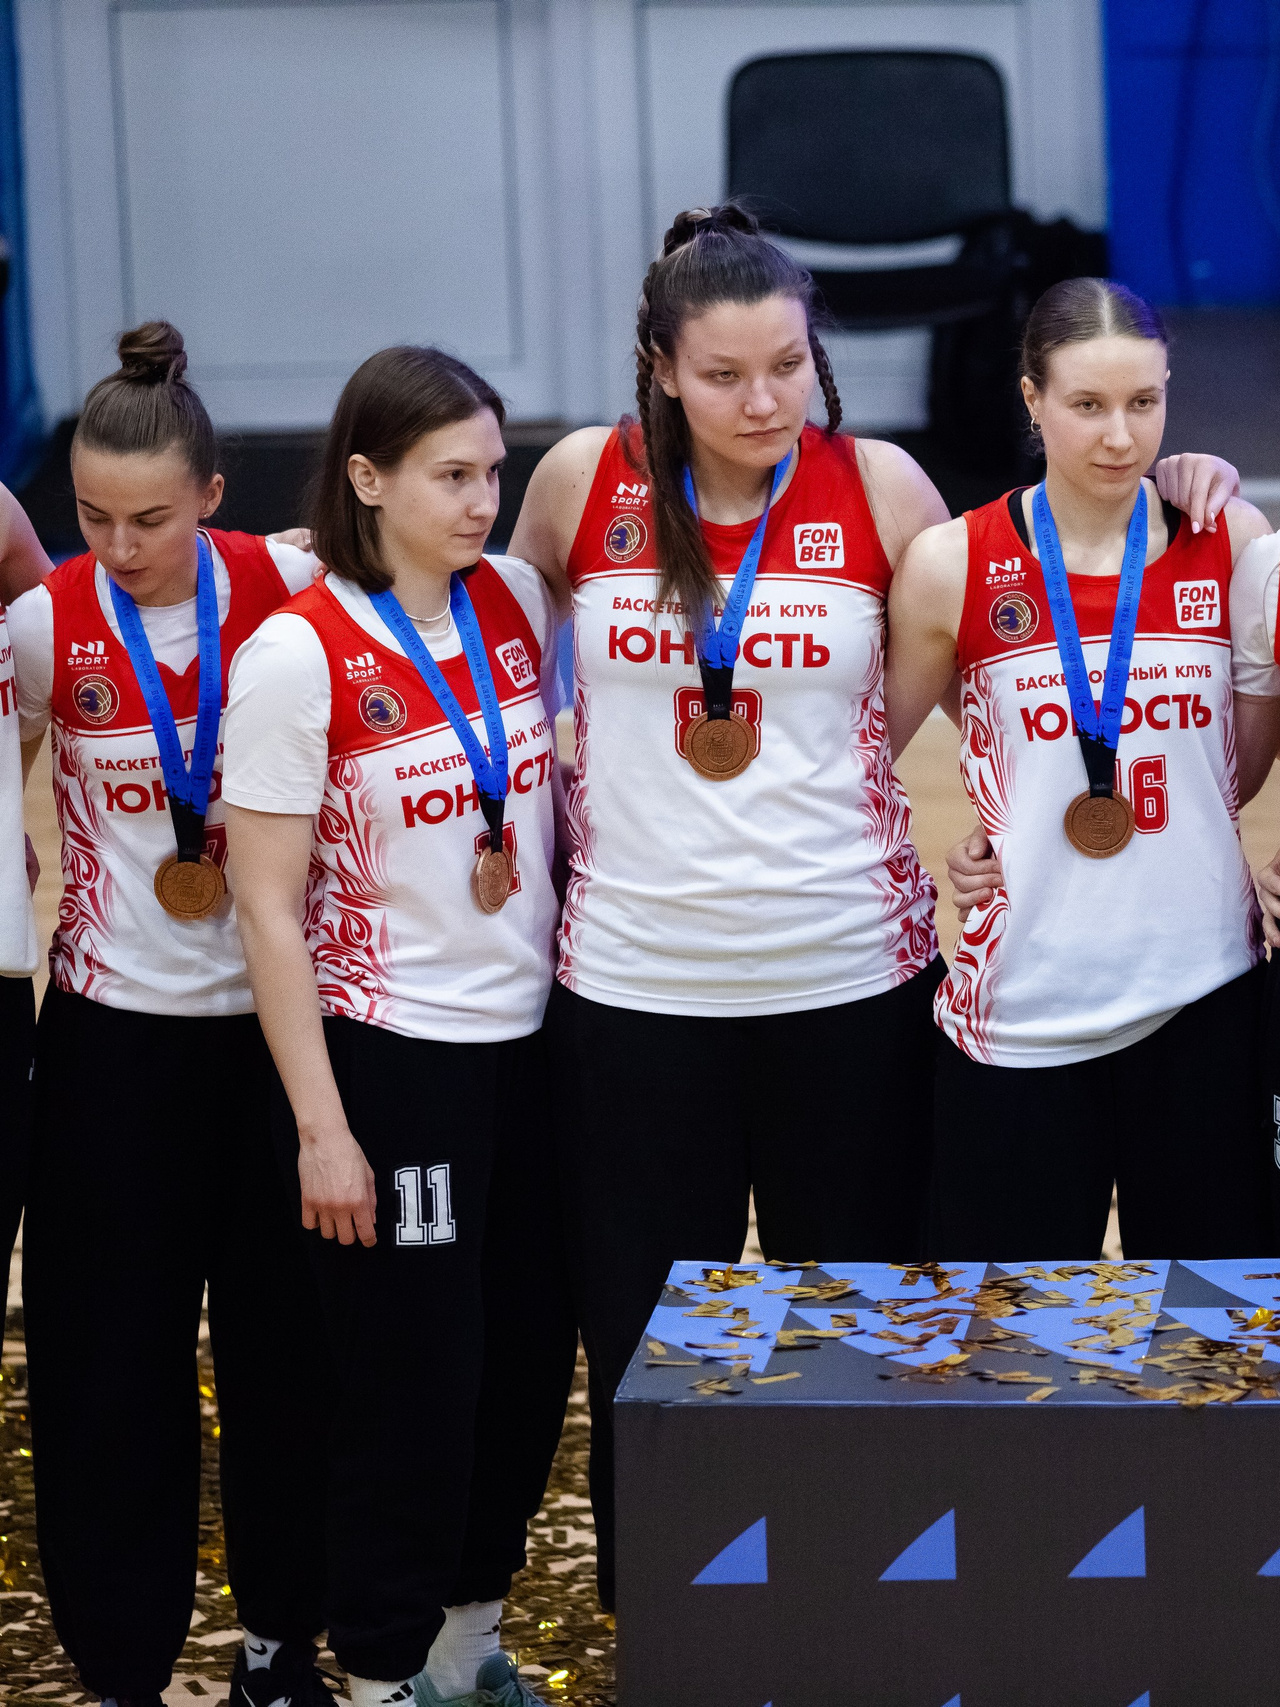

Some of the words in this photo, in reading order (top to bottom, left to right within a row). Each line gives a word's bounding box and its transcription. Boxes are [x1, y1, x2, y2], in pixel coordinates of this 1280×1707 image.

[611, 496, 648, 506] SPORT
[799, 529, 838, 544] FON
[800, 546, 840, 562] BET
[1128, 537, 1140, 569] РОССИИ
[985, 572, 1027, 585] SPORT
[612, 597, 770, 617] БАСКЕТБЬЫЙ
[780, 604, 828, 617] КЛУБ
[1120, 574, 1135, 624] ЧЕМПИОНАТ
[1179, 585, 1215, 604] FON
[1040, 527, 1060, 576] ЧЕМПИОНАТ
[1052, 580, 1069, 614] РОССИИ
[1063, 635, 1084, 691] БАСКЕТБОЛУ
[1180, 604, 1218, 622] BET
[465, 629, 486, 679] ЧЕМПИОНАТ
[502, 644, 525, 666] FON
[608, 625, 831, 668] ЮНСТЬ
[1114, 628, 1127, 662] FONBET
[68, 657, 109, 665] SPORT
[346, 666, 382, 680] SPORT
[511, 660, 533, 683] BET
[387, 606, 420, 653] ЧЕМПИОНАТ
[417, 653, 440, 686] РОССИИ
[445, 702, 480, 754] БАСКЕТБОЛУ
[1016, 663, 1167, 691] БАСКЕОНЫЙ
[1176, 665, 1212, 678] КЛУБ
[1109, 668, 1120, 693] XXXIV
[480, 683, 495, 716] FONBET
[490, 720, 503, 746] XXXIV
[395, 728, 527, 780] БАСКЕТБЬЫЙ
[1113, 754, 1169, 834] 6
[395, 1163, 456, 1245] 11
